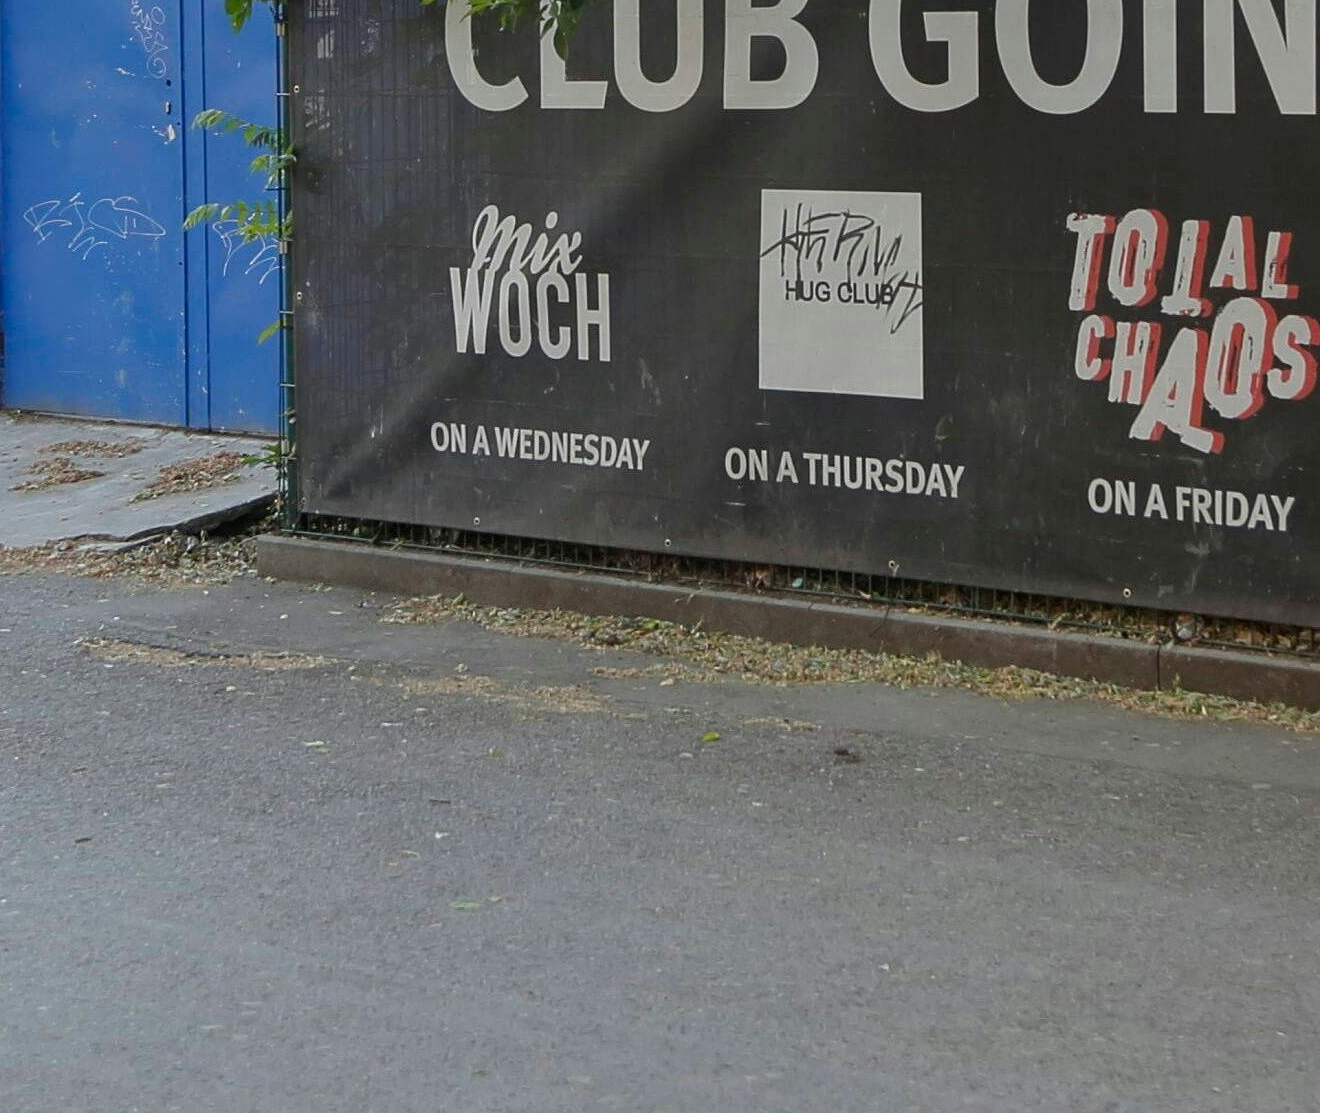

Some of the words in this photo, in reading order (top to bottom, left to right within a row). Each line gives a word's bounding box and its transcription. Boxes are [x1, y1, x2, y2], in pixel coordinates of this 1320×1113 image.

[472, 204, 583, 276] Mix
[1065, 208, 1300, 318] TOTAL
[449, 266, 611, 362] WOCH
[784, 279, 830, 302] HUG
[837, 282, 894, 306] CLUB
[430, 421, 467, 454] ON
[471, 424, 491, 457] A
[493, 426, 651, 471] WEDNESDAY
[724, 447, 769, 482] ON
[775, 450, 799, 484] A
[802, 452, 965, 499] THURSDAY
[1087, 477, 1136, 517] ON
[1143, 483, 1169, 520] A
[1175, 485, 1296, 532] FRIDAY
